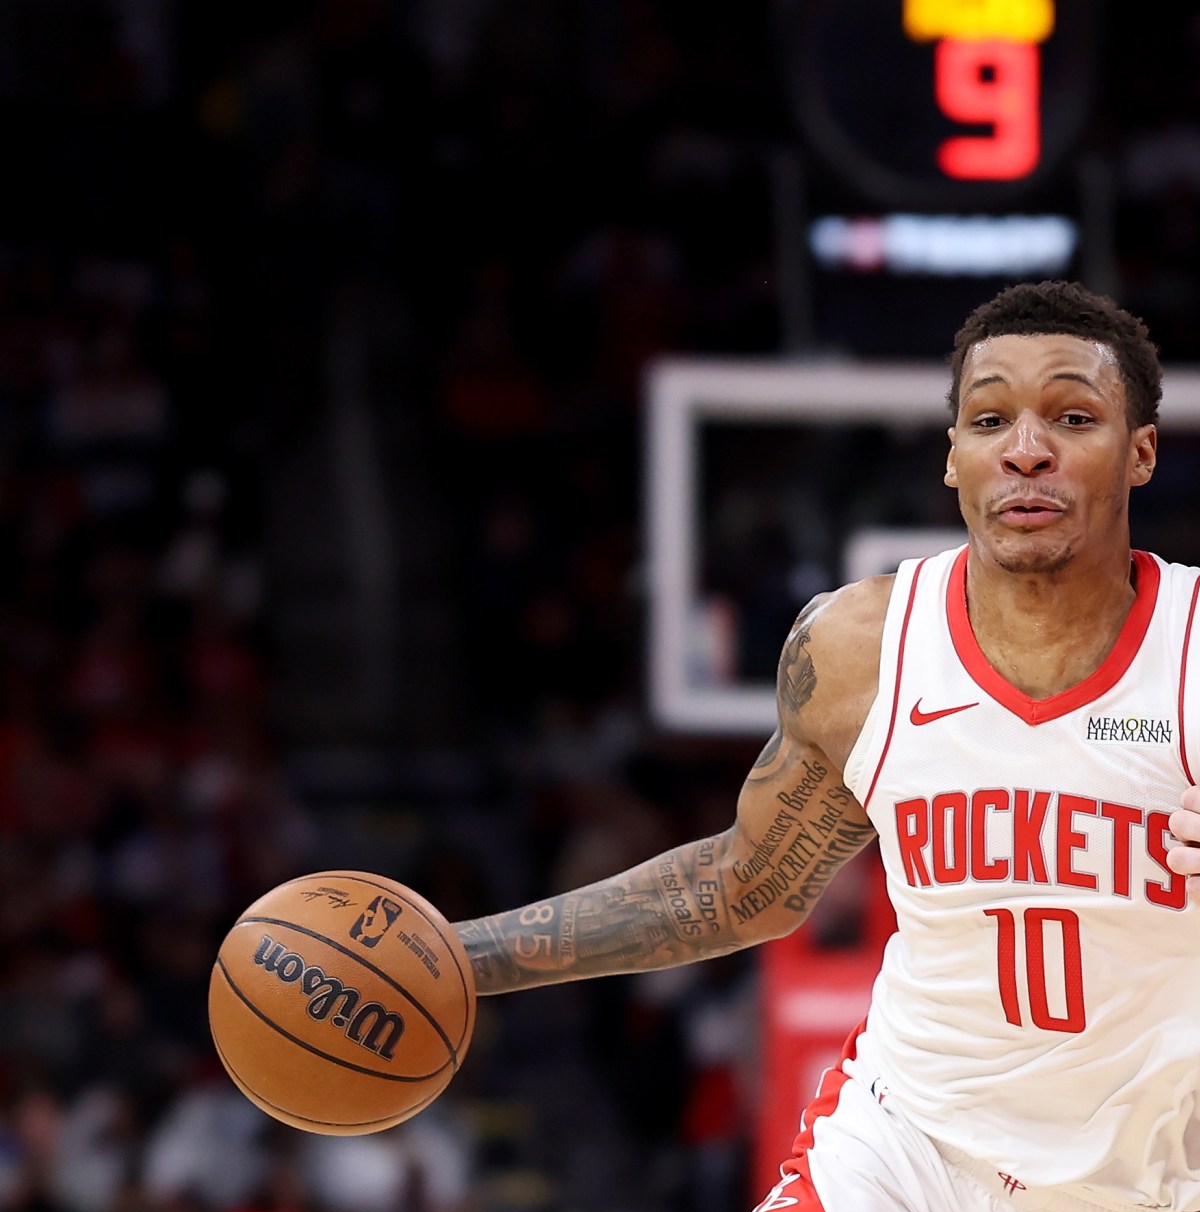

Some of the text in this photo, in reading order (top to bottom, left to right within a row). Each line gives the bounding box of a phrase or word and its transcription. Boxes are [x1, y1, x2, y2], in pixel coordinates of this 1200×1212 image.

[935, 36, 1041, 180] 9
[1087, 727, 1172, 743] HERMANN
[1088, 716, 1173, 733] MEMORIAL
[698, 836, 721, 867] an
[730, 827, 822, 925] MEDIOCRITY
[808, 800, 844, 839] And
[732, 760, 828, 884] Complacency Breeds
[783, 819, 877, 913] POTENTIAL
[893, 787, 1188, 911] ROCKETS
[514, 904, 554, 958] 85
[983, 907, 1086, 1034] 10
[253, 934, 405, 1062] Wilson
